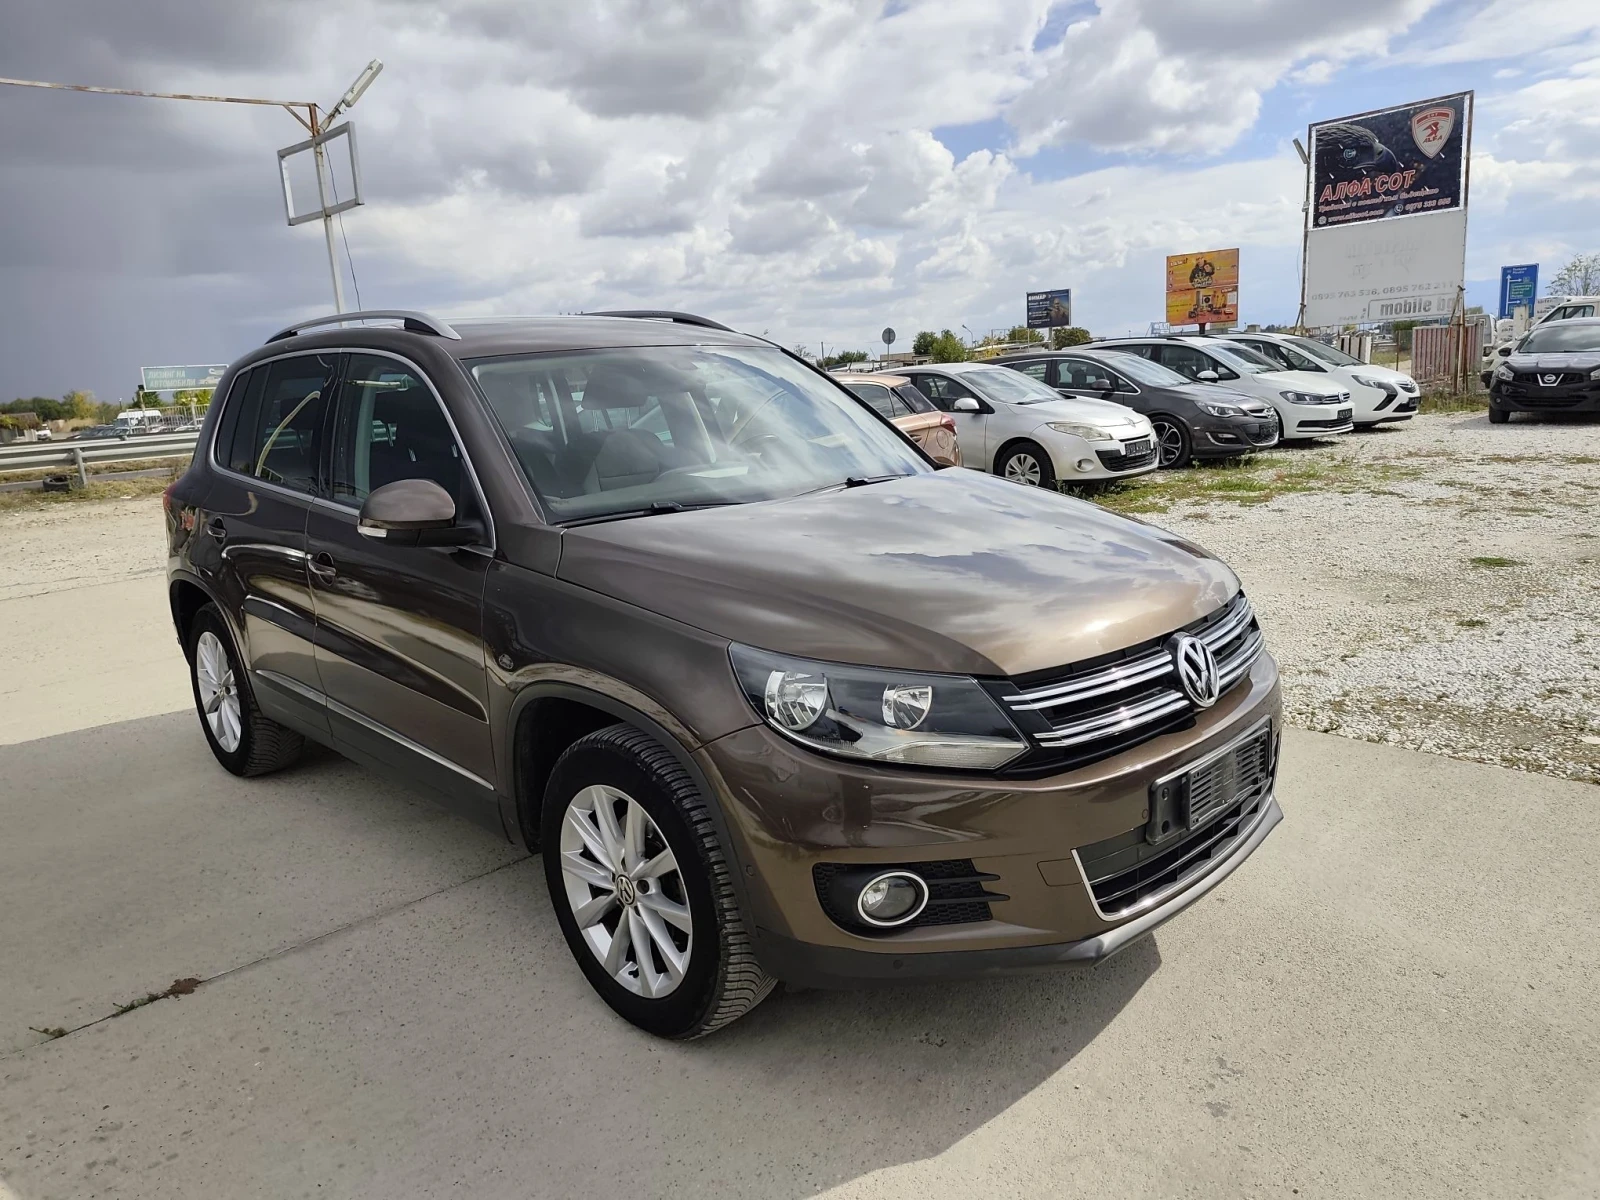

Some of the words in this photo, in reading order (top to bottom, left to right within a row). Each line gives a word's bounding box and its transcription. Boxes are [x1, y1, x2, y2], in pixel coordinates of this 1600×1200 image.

[1423, 135, 1443, 144] ALFA
[1320, 177, 1371, 202] АЛФА
[1375, 169, 1416, 192] СОТ
[1382, 285, 1408, 294] 0895
[1380, 297, 1432, 316] mobile
[177, 370, 185, 378] НА
[150, 378, 196, 388] АВТОМОБИЛИ
